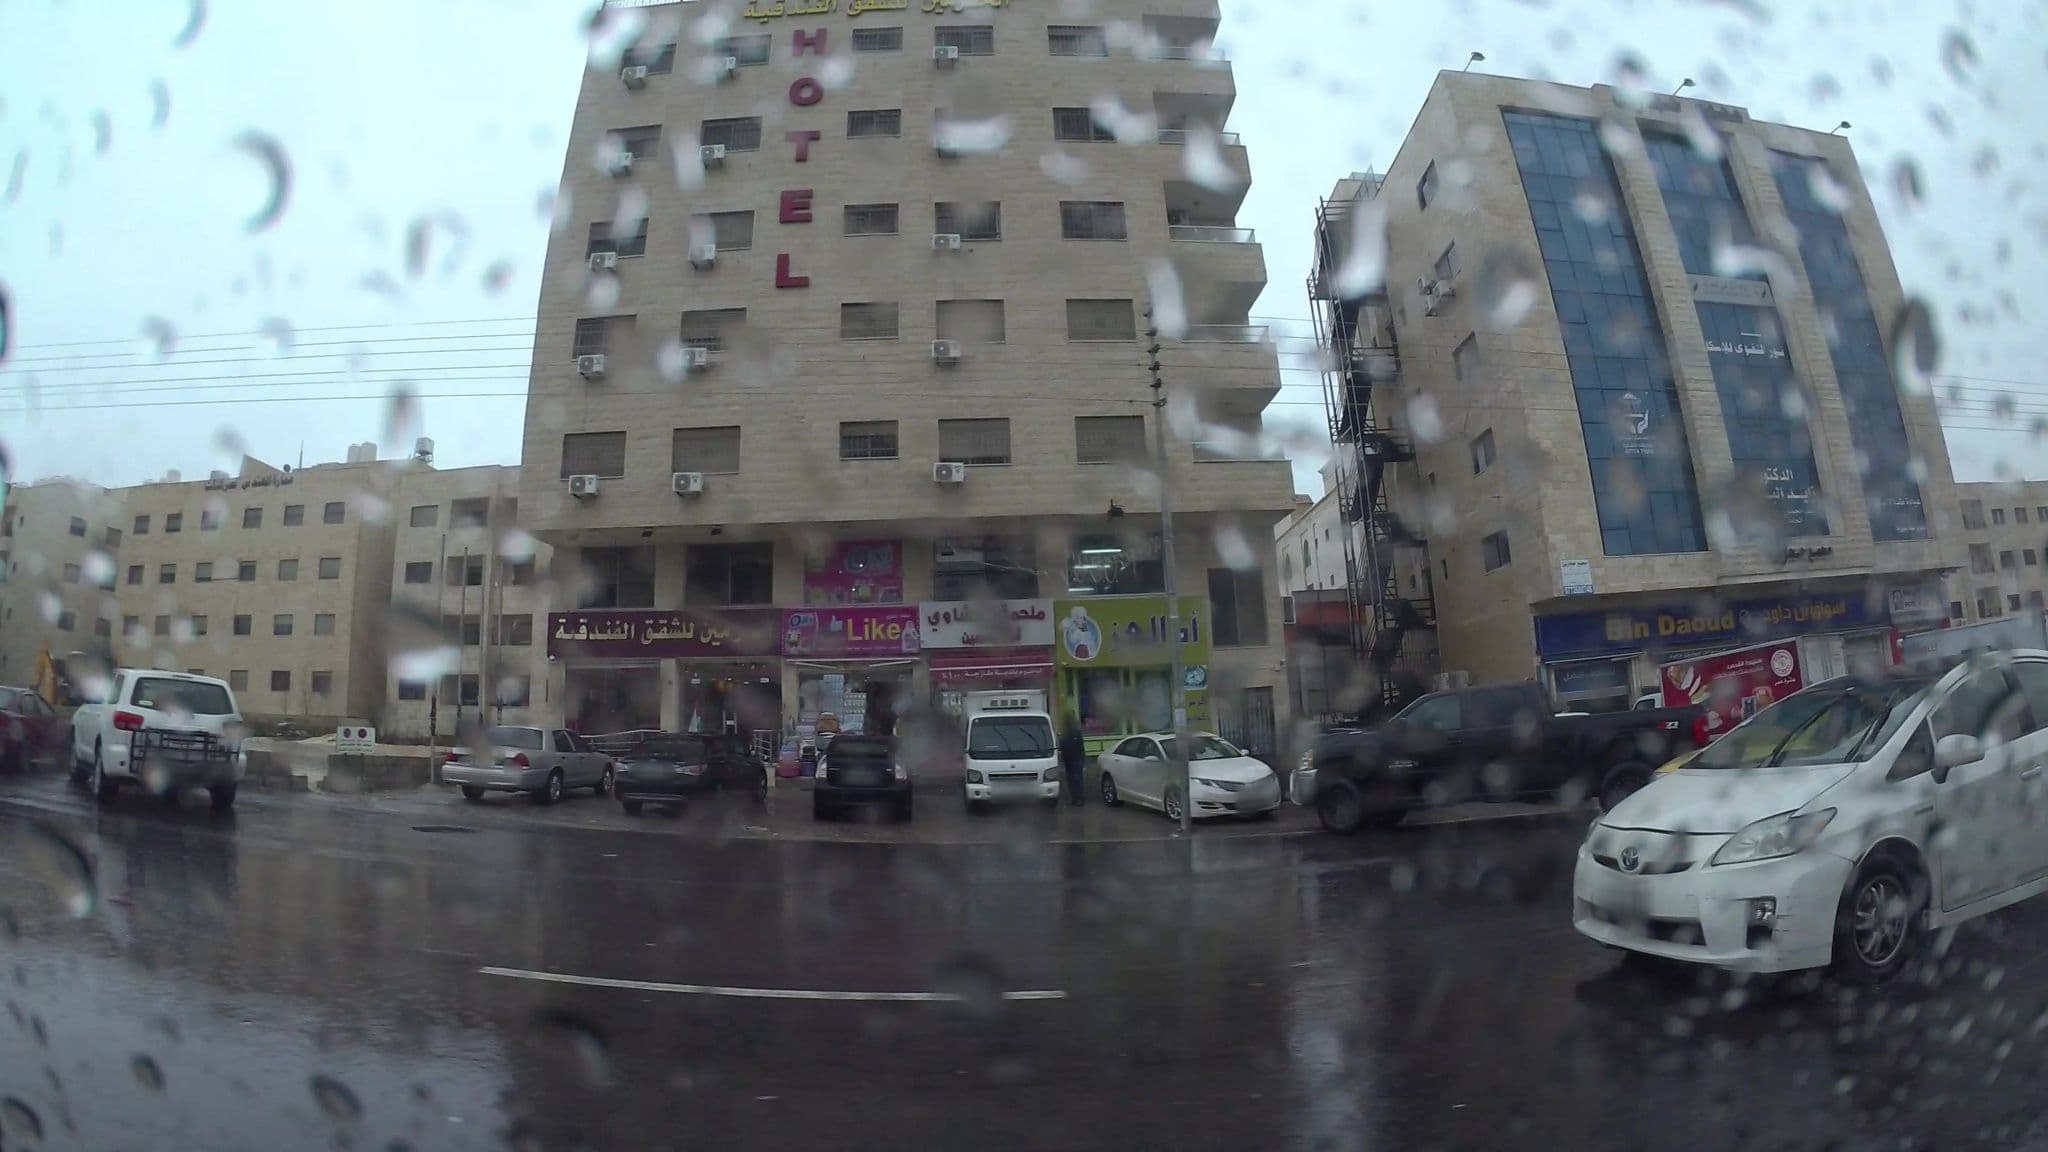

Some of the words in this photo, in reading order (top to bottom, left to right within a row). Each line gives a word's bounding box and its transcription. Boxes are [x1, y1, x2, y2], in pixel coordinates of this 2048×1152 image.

[776, 28, 827, 288] HOTEL
[641, 617, 695, 645] للشقق
[847, 617, 901, 641] Like
[1605, 612, 1649, 641] Bin
[1658, 610, 1736, 637] Daoud
